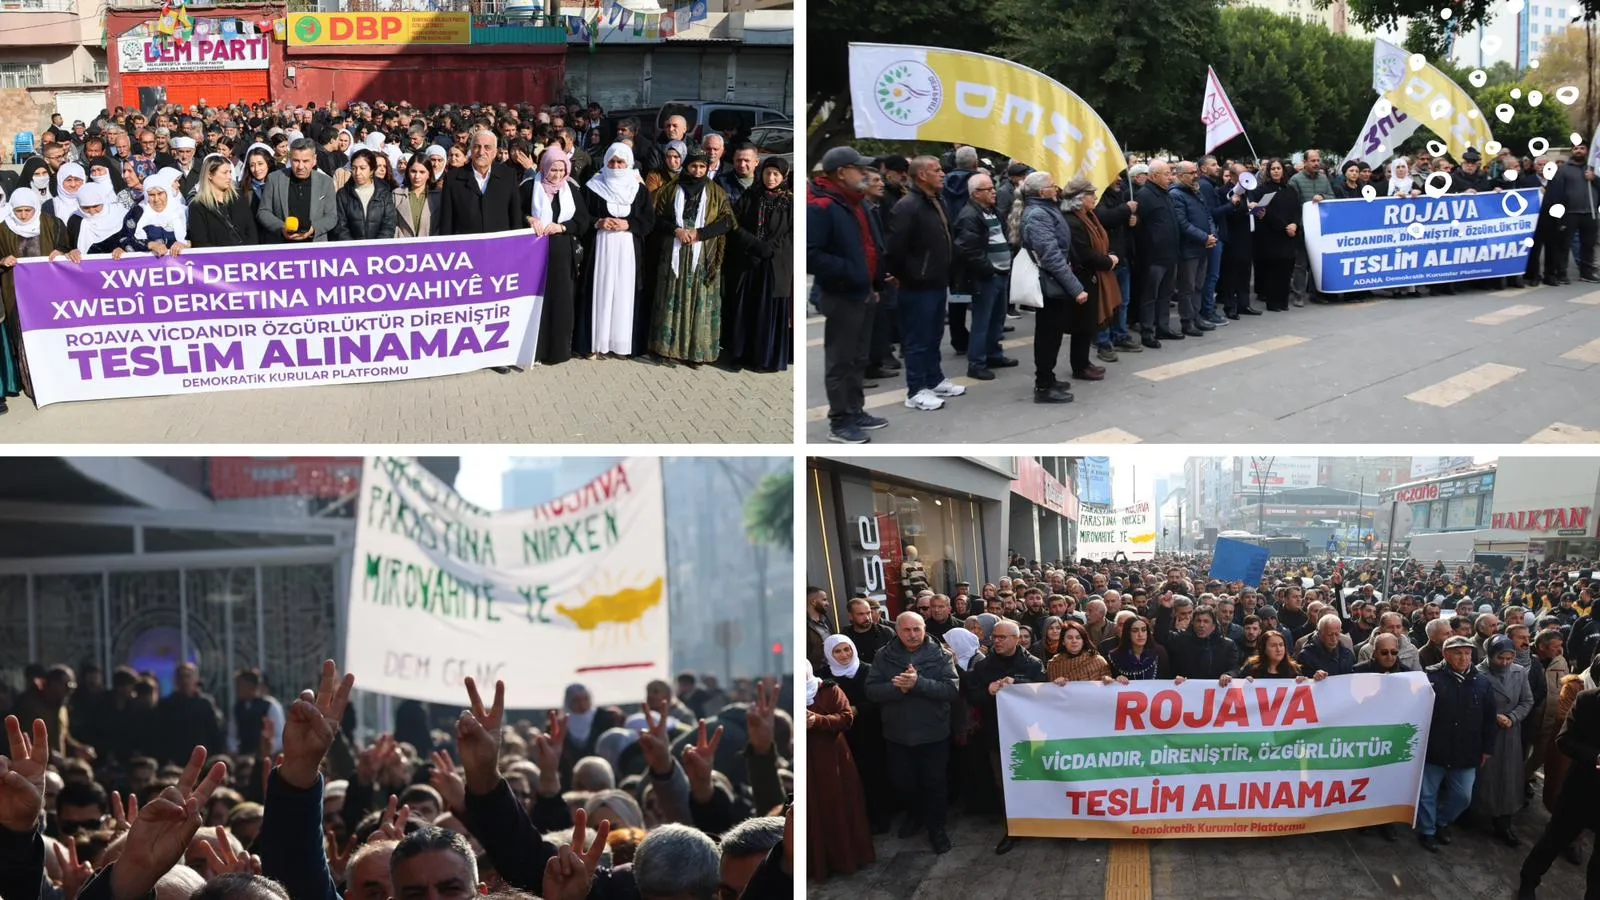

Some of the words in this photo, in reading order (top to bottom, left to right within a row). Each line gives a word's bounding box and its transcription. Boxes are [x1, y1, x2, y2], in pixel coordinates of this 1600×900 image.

[329, 16, 402, 40] DBP
[144, 41, 191, 62] DEM
[198, 35, 268, 61] PARTİ
[956, 80, 1082, 163] DEM
[1383, 199, 1479, 226] ROJAVA
[1336, 233, 1397, 248] VİCDANDIR,
[1466, 219, 1532, 237] ÖZGÜRLÜKTÜR
[100, 261, 194, 289] XWEDÎ
[202, 257, 359, 285] DERKETINA
[366, 249, 475, 277] ROJAVA
[1340, 248, 1419, 277] TESLİM
[1422, 240, 1529, 268] ALINAMAZ
[51, 292, 145, 320] XWEDÎ
[153, 288, 308, 315] DERKETINA
[317, 275, 484, 306] MIROVAHIYÊ
[488, 272, 520, 295] YE
[1352, 276, 1384, 286] ADANA
[1385, 272, 1425, 283] Demokratik
[65, 332, 144, 348] ROJAVA
[261, 314, 405, 338] ÖZGÜRLÜKTÜR
[260, 320, 511, 368] ALINAMAZ
[268, 369, 329, 384] KURULAR
[332, 364, 409, 379] PLATFORMU
[1396, 483, 1438, 503] eczane
[1491, 506, 1591, 533] HALKTAN
[522, 509, 619, 565] NIRXEN
[518, 584, 551, 624] YE
[383, 650, 430, 680] DEM
[1114, 684, 1320, 731] ROJAVA
[1041, 748, 1145, 771] VİCDANDIR,
[1150, 744, 1254, 767] DİRENİŞTİR,
[1258, 737, 1393, 760] ÖZGÜRLÜKTÜR
[1066, 777, 1185, 816] TESLİM
[1192, 776, 1371, 812] ALINAMAZ
[1131, 821, 1196, 836] Demokratik
[1198, 820, 1249, 834] Kurumlar
[1250, 819, 1307, 833] Platformu
